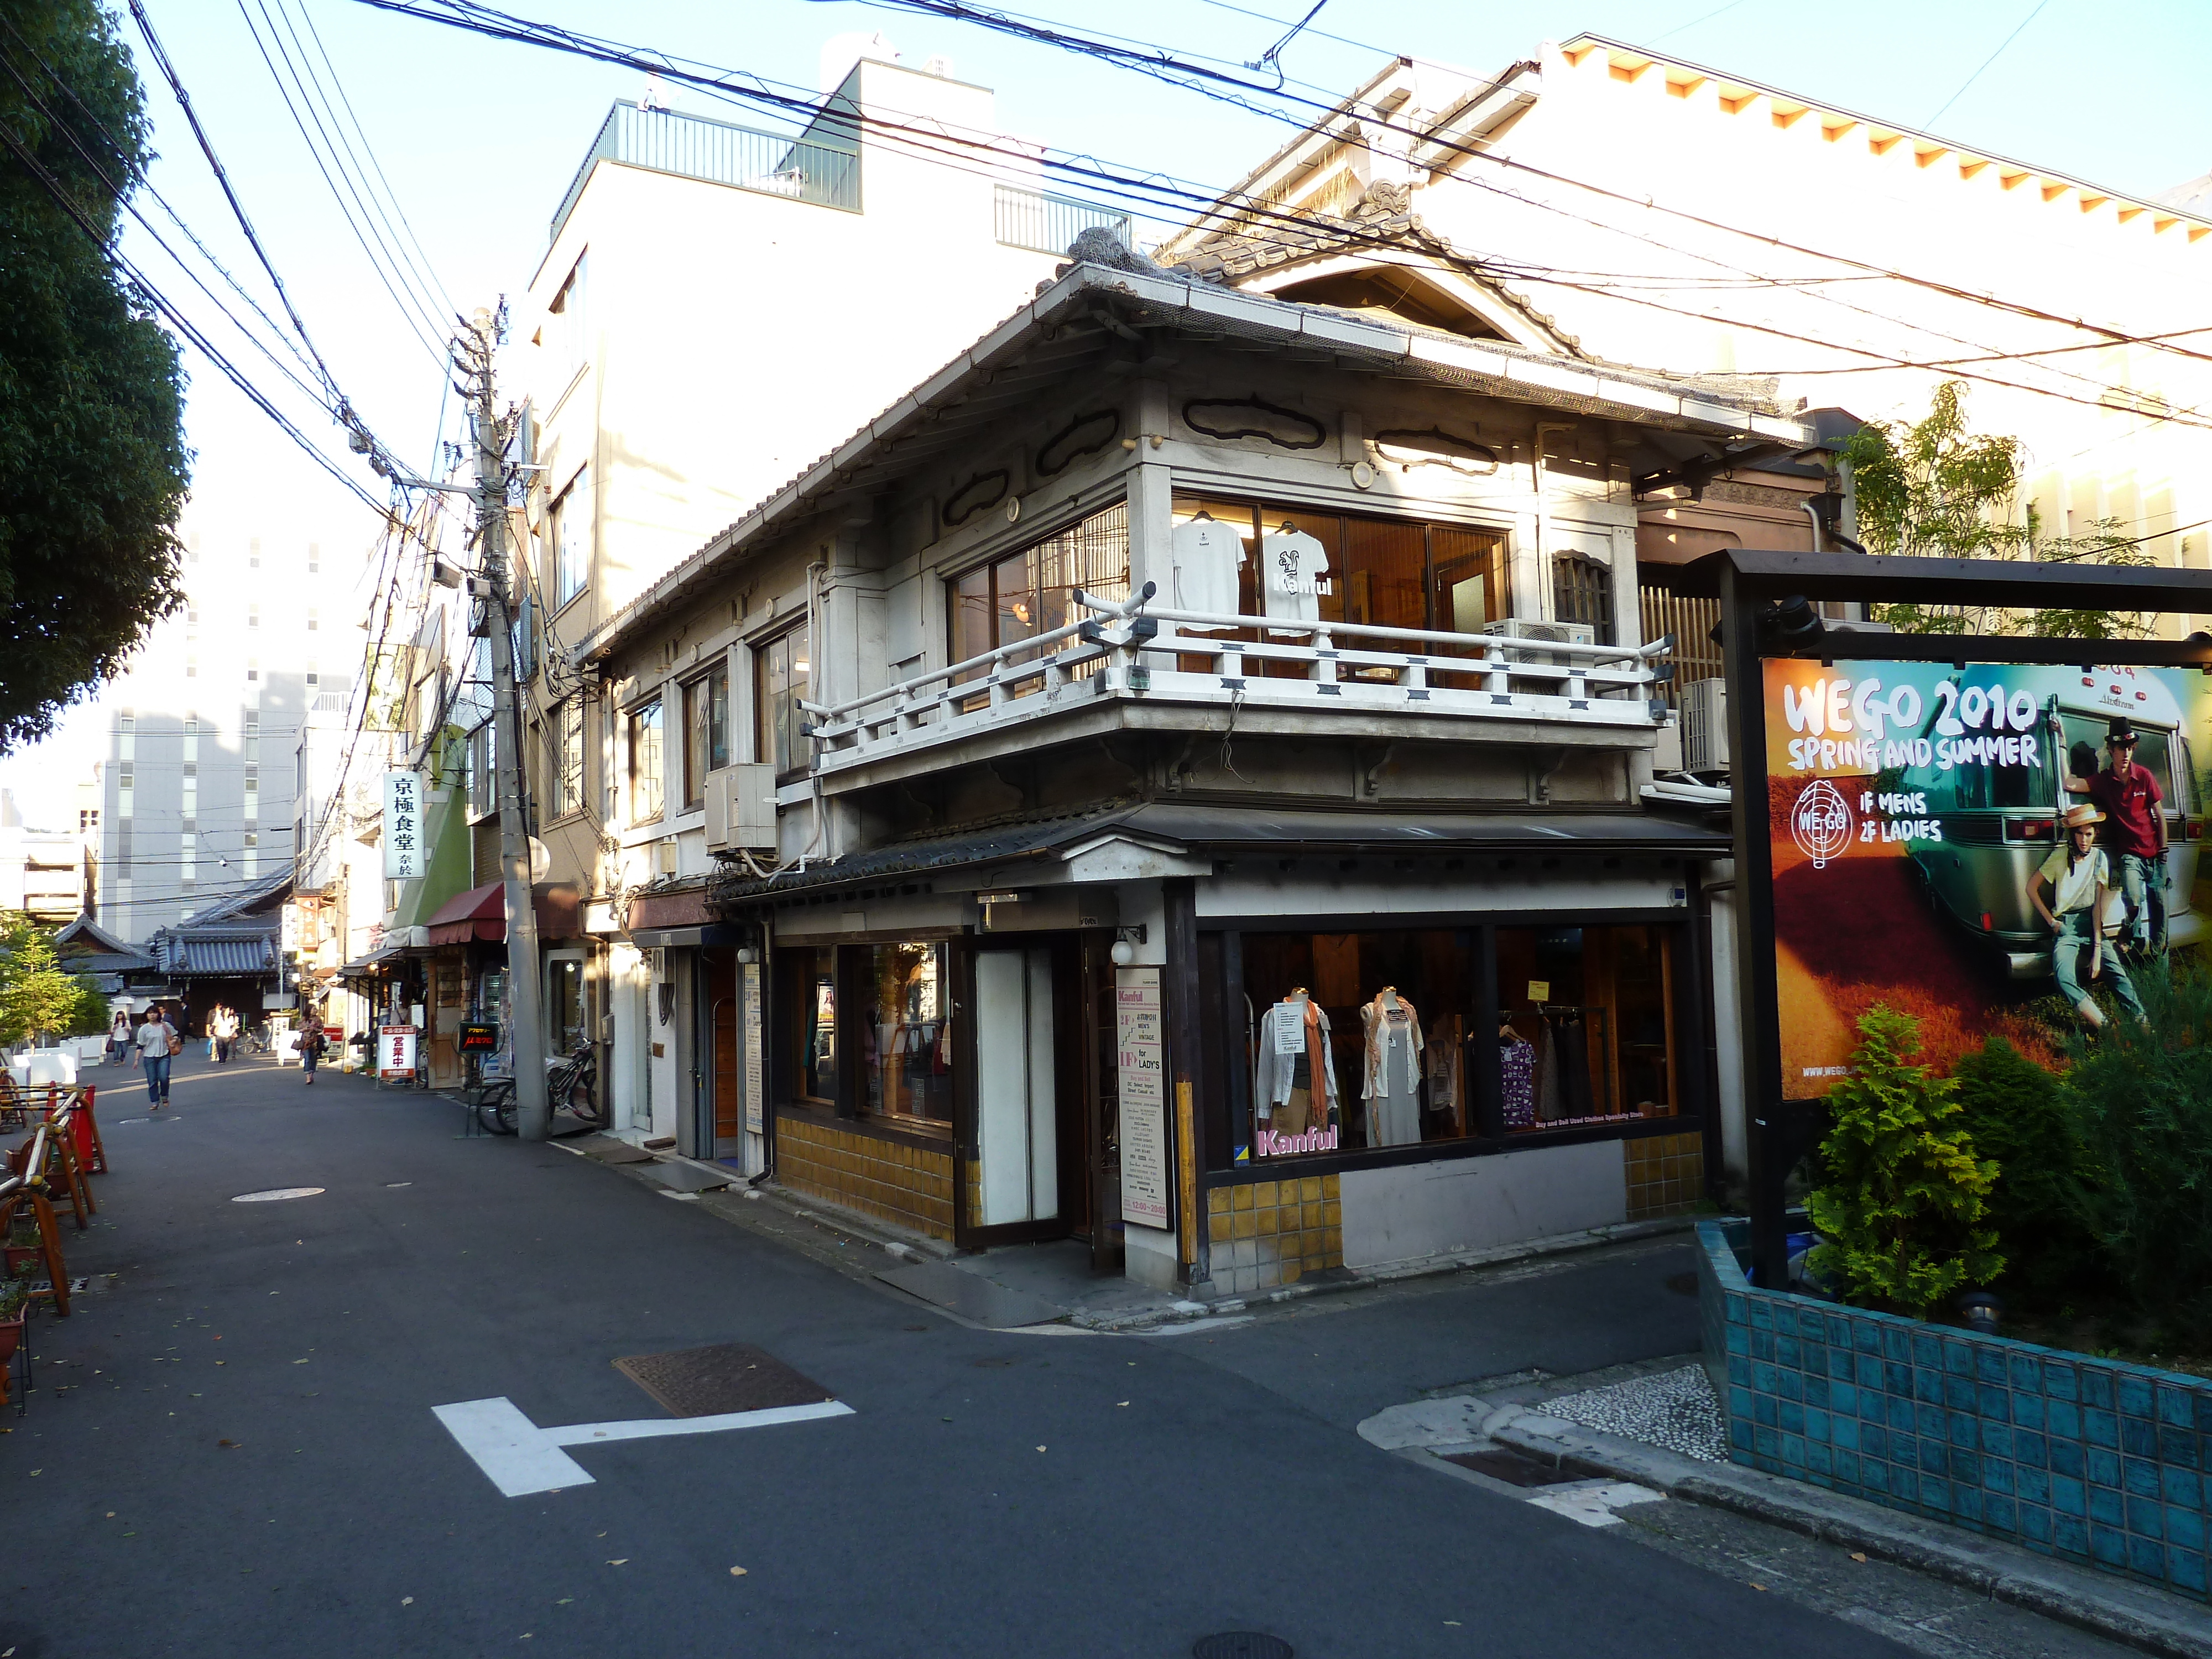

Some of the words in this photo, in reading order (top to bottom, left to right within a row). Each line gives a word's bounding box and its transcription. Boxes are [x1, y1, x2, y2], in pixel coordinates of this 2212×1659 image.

[1273, 572, 1332, 596] Kanful
[1785, 678, 1922, 739] WEGO
[1934, 680, 2037, 736] 2010
[1788, 736, 1881, 773] SPRING
[1884, 738, 1933, 768] AND
[1935, 734, 2042, 770] SUMMER
[392, 777, 415, 851] 京極食堂
[1878, 792, 1927, 815] MENS
[1859, 820, 1877, 843] 2F
[1881, 819, 1942, 842] LADIES
[1118, 990, 1143, 1002] Kanful
[393, 1036, 405, 1067] 営業中
[1119, 1051, 1134, 1067] 1F
[1139, 1060, 1160, 1070] LADY'S
[1605, 1113, 1629, 1121] Specialty
[1258, 1124, 1338, 1157] Kanful
